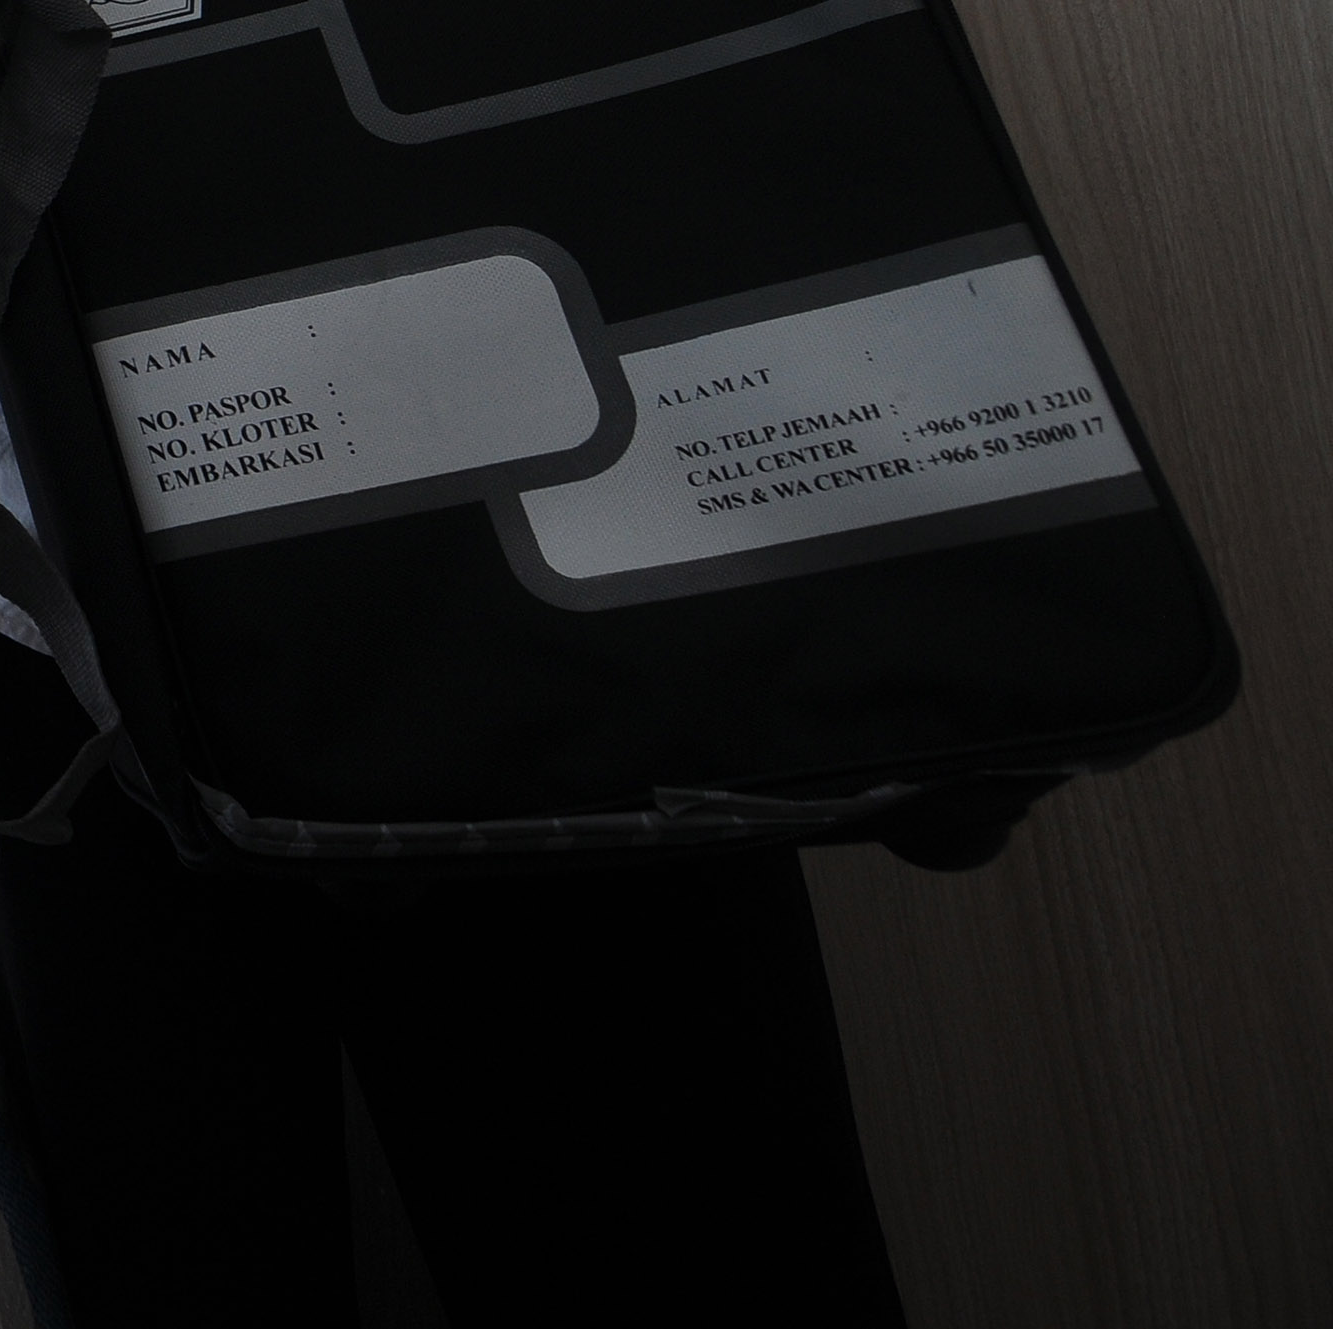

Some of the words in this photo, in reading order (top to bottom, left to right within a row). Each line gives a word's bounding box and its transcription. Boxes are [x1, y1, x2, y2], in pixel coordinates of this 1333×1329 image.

[118, 341, 216, 379] NAMA
[137, 408, 185, 435] NO.
[188, 385, 292, 424] PASPOR
[655, 367, 771, 410] ALAMAT
[146, 437, 196, 465] NO.
[202, 412, 319, 453] KLOTER
[675, 440, 717, 461] NO.
[717, 425, 776, 452] TELP
[782, 403, 881, 438] JEMAAH
[687, 462, 753, 487] CALL
[756, 438, 858, 472] CENTER
[915, 416, 966, 438] +966
[968, 403, 1019, 427] 9200
[1025, 399, 1036, 415] 1
[1042, 387, 1092, 412] 3210
[156, 441, 325, 493] EMBARKASI
[697, 492, 746, 515] SMS
[751, 488, 769, 505] &
[928, 444, 978, 466] +966
[983, 437, 1009, 457] 50
[1013, 423, 1077, 451] 35000
[1082, 417, 1105, 436] 17
